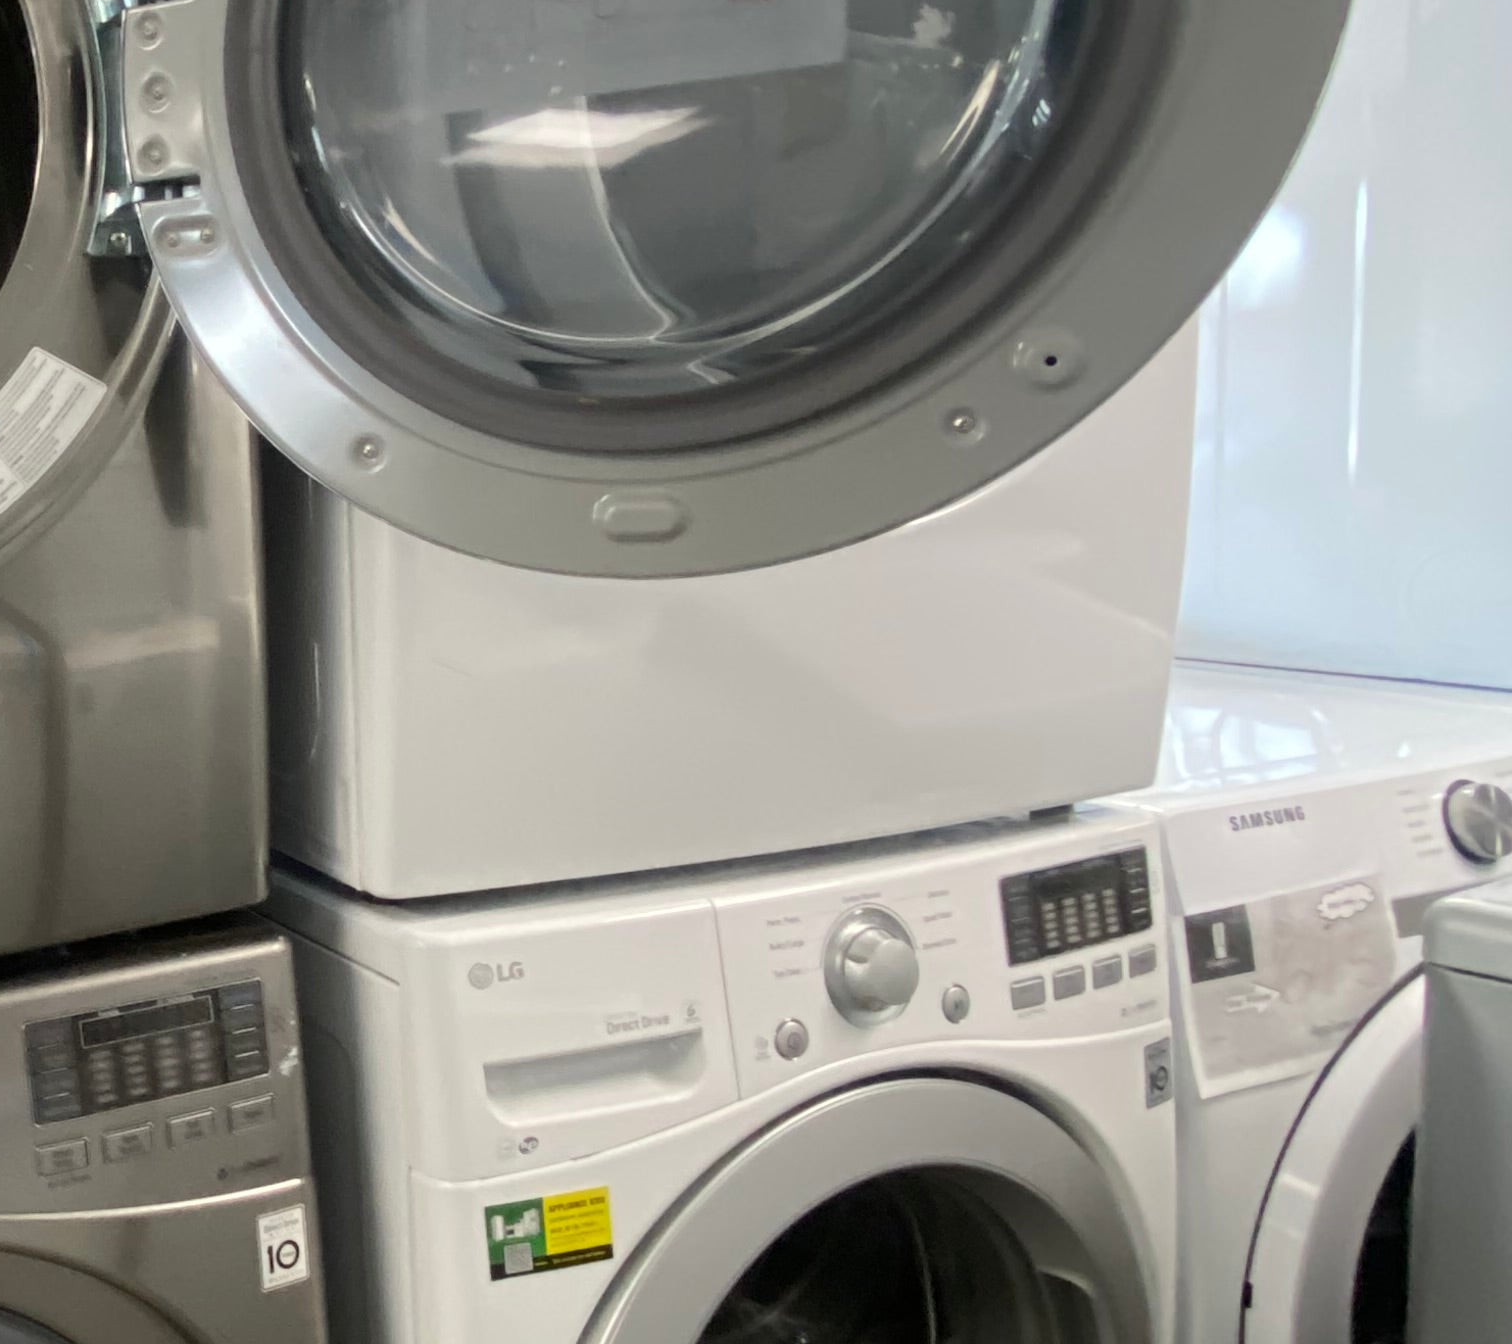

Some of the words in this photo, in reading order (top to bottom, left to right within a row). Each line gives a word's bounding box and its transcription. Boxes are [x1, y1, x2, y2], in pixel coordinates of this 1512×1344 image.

[1229, 805, 1306, 832] SAMSUNG
[495, 960, 525, 984] LG
[606, 1018, 640, 1035] Direct
[641, 1014, 670, 1028] Drive
[267, 1239, 300, 1275] 10
